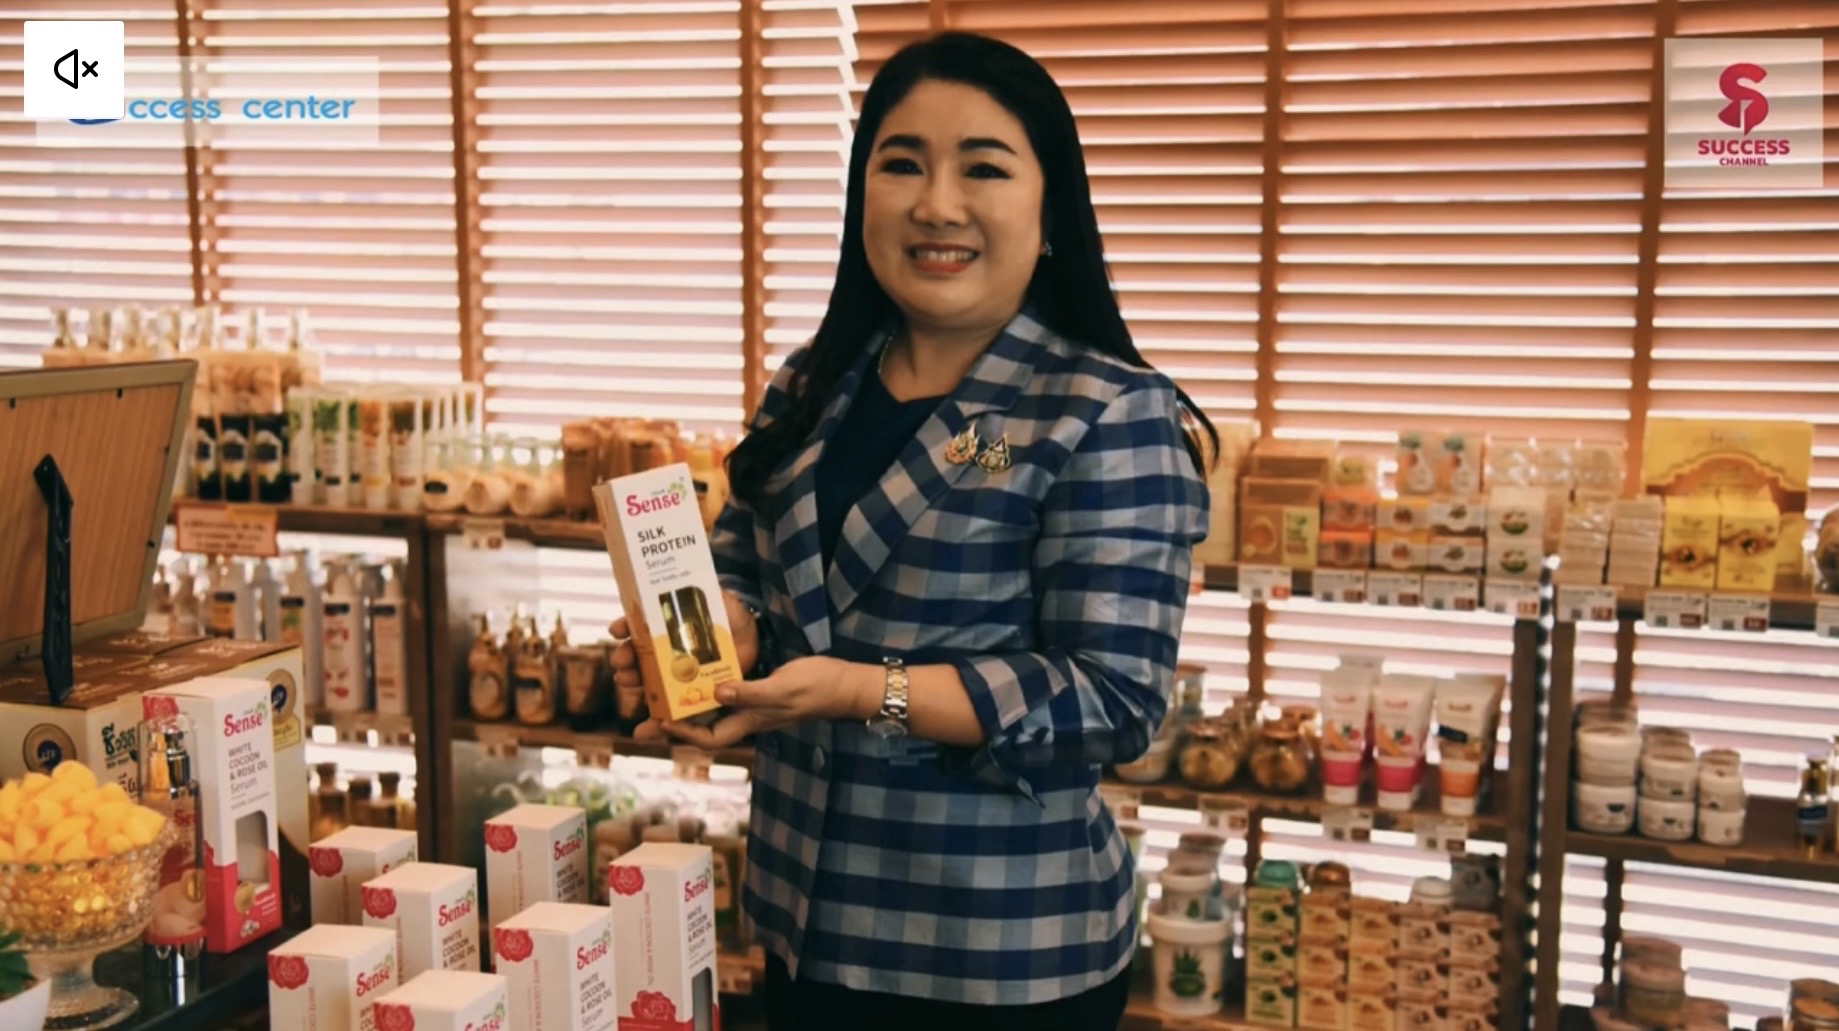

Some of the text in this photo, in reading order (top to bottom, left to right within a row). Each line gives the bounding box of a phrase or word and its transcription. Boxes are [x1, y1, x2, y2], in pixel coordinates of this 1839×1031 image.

[626, 492, 681, 516] Sense
[638, 526, 666, 543] SILK
[641, 534, 697, 558] PROTEIN
[645, 556, 675, 570] Serum
[223, 712, 263, 737] Sense
[228, 742, 252, 757] WHITE
[229, 752, 260, 769] COCOON
[230, 759, 268, 781] & ROSE OIL
[230, 777, 257, 793] Serum
[553, 838, 581, 861] Sense
[684, 879, 708, 902] Sense
[438, 900, 471, 927] Sense
[687, 905, 702, 921] WHITE
[687, 913, 708, 932] COCOON
[442, 929, 463, 946] WHITE
[692, 926, 705, 940] ROSE
[443, 938, 469, 957] COCOON
[576, 941, 607, 970] Sense
[356, 968, 390, 997] Sense
[580, 972, 599, 990] WHITE
[580, 981, 606, 1002] COCOON
[586, 995, 602, 1010] ROSE
